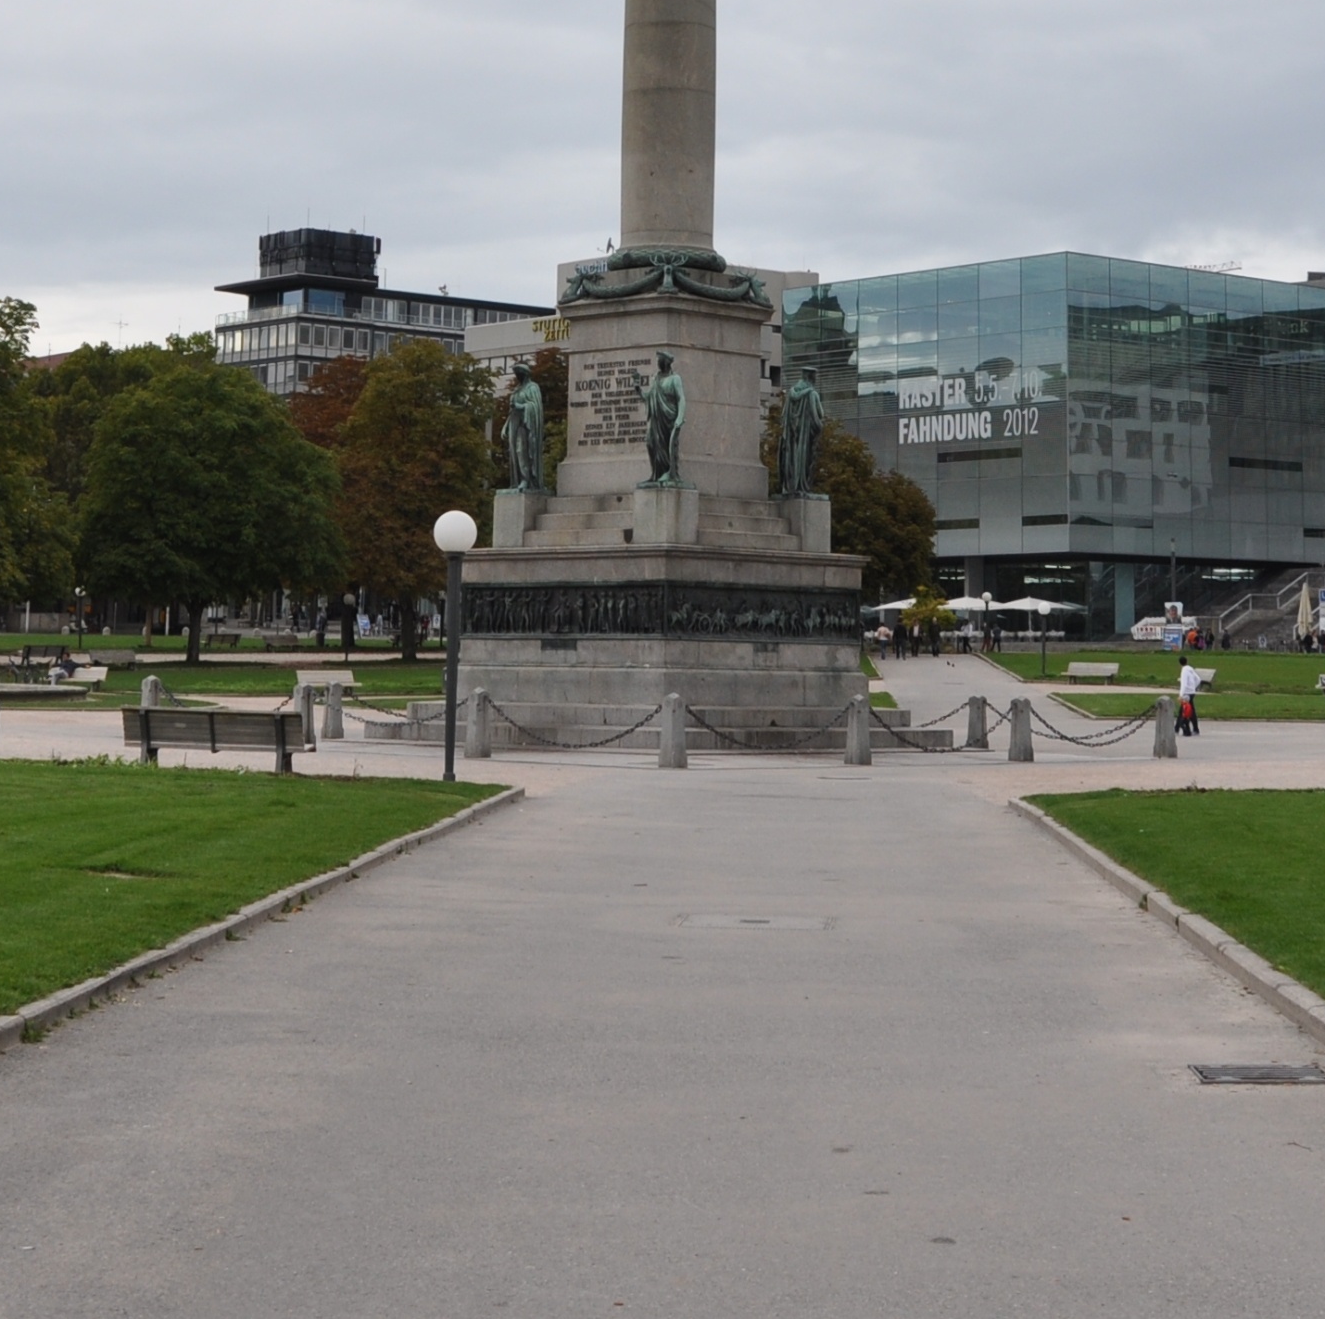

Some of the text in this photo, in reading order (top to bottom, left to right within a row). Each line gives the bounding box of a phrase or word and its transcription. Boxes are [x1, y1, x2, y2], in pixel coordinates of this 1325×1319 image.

[532, 317, 571, 333] STUTTG
[543, 327, 571, 342] ZEIT
[575, 378, 610, 391] KOENIG
[898, 377, 966, 410] RASTER
[898, 407, 1039, 445] FAHNDUNG 2012
